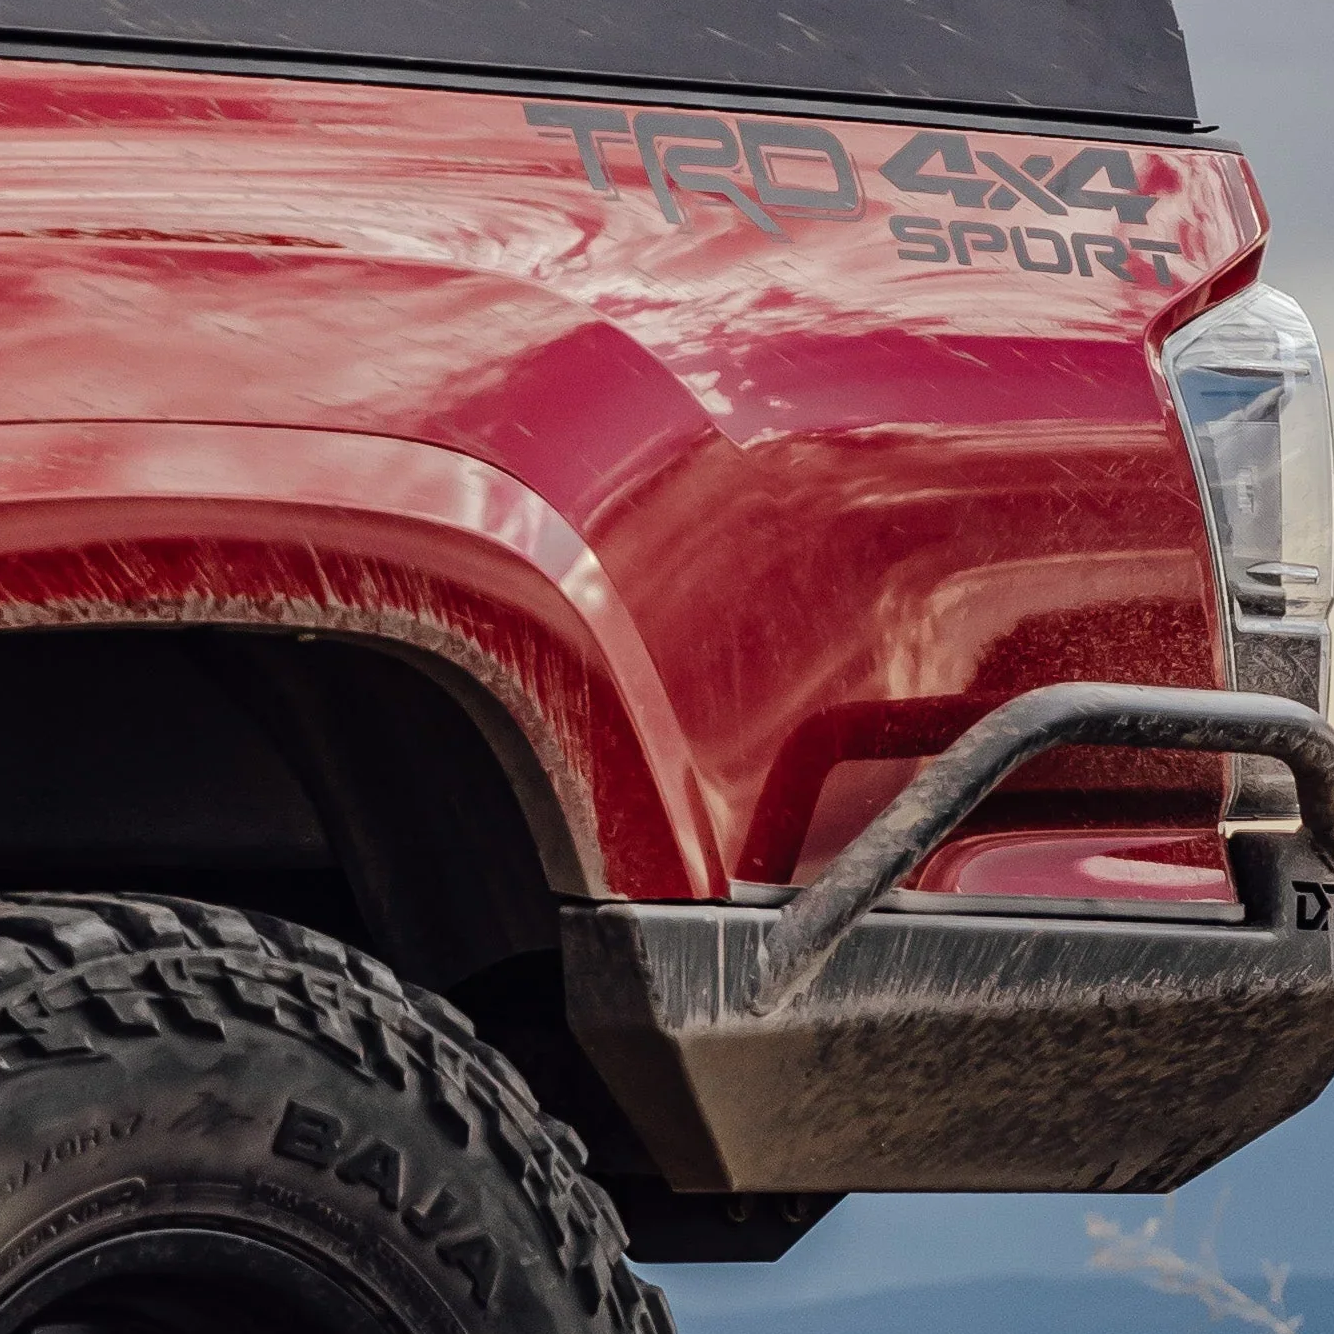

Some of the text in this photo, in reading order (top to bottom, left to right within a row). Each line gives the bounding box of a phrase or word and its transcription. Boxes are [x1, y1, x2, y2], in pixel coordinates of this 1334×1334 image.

[523, 102, 864, 244] TRD
[889, 215, 1182, 287] SPORT
[271, 1099, 503, 1312] BAJA
